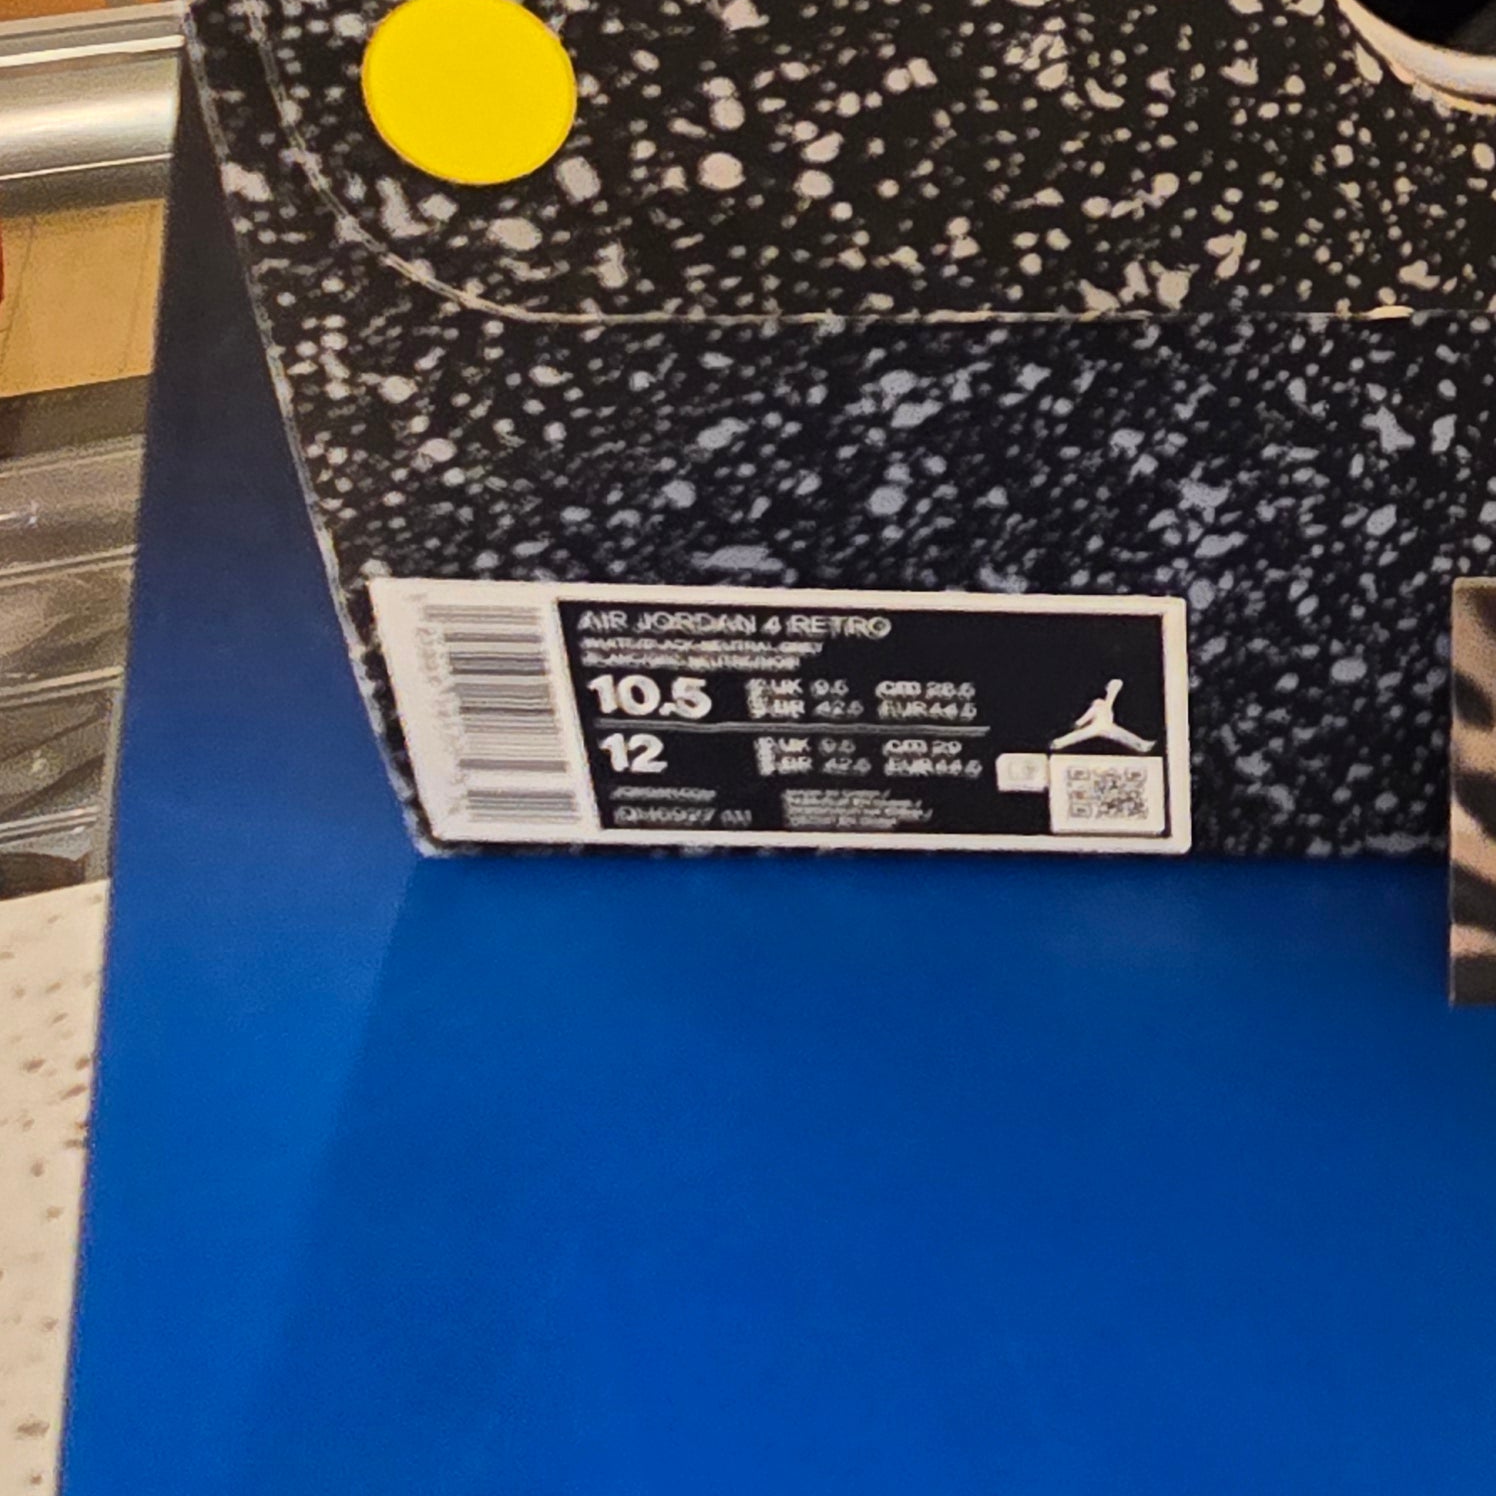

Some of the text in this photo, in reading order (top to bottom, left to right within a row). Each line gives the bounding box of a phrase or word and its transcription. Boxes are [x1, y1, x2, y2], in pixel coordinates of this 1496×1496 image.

[577, 610, 891, 639] AIR JORDAN 4 RETRO
[587, 673, 713, 720] 10.5
[599, 733, 667, 774] 12
